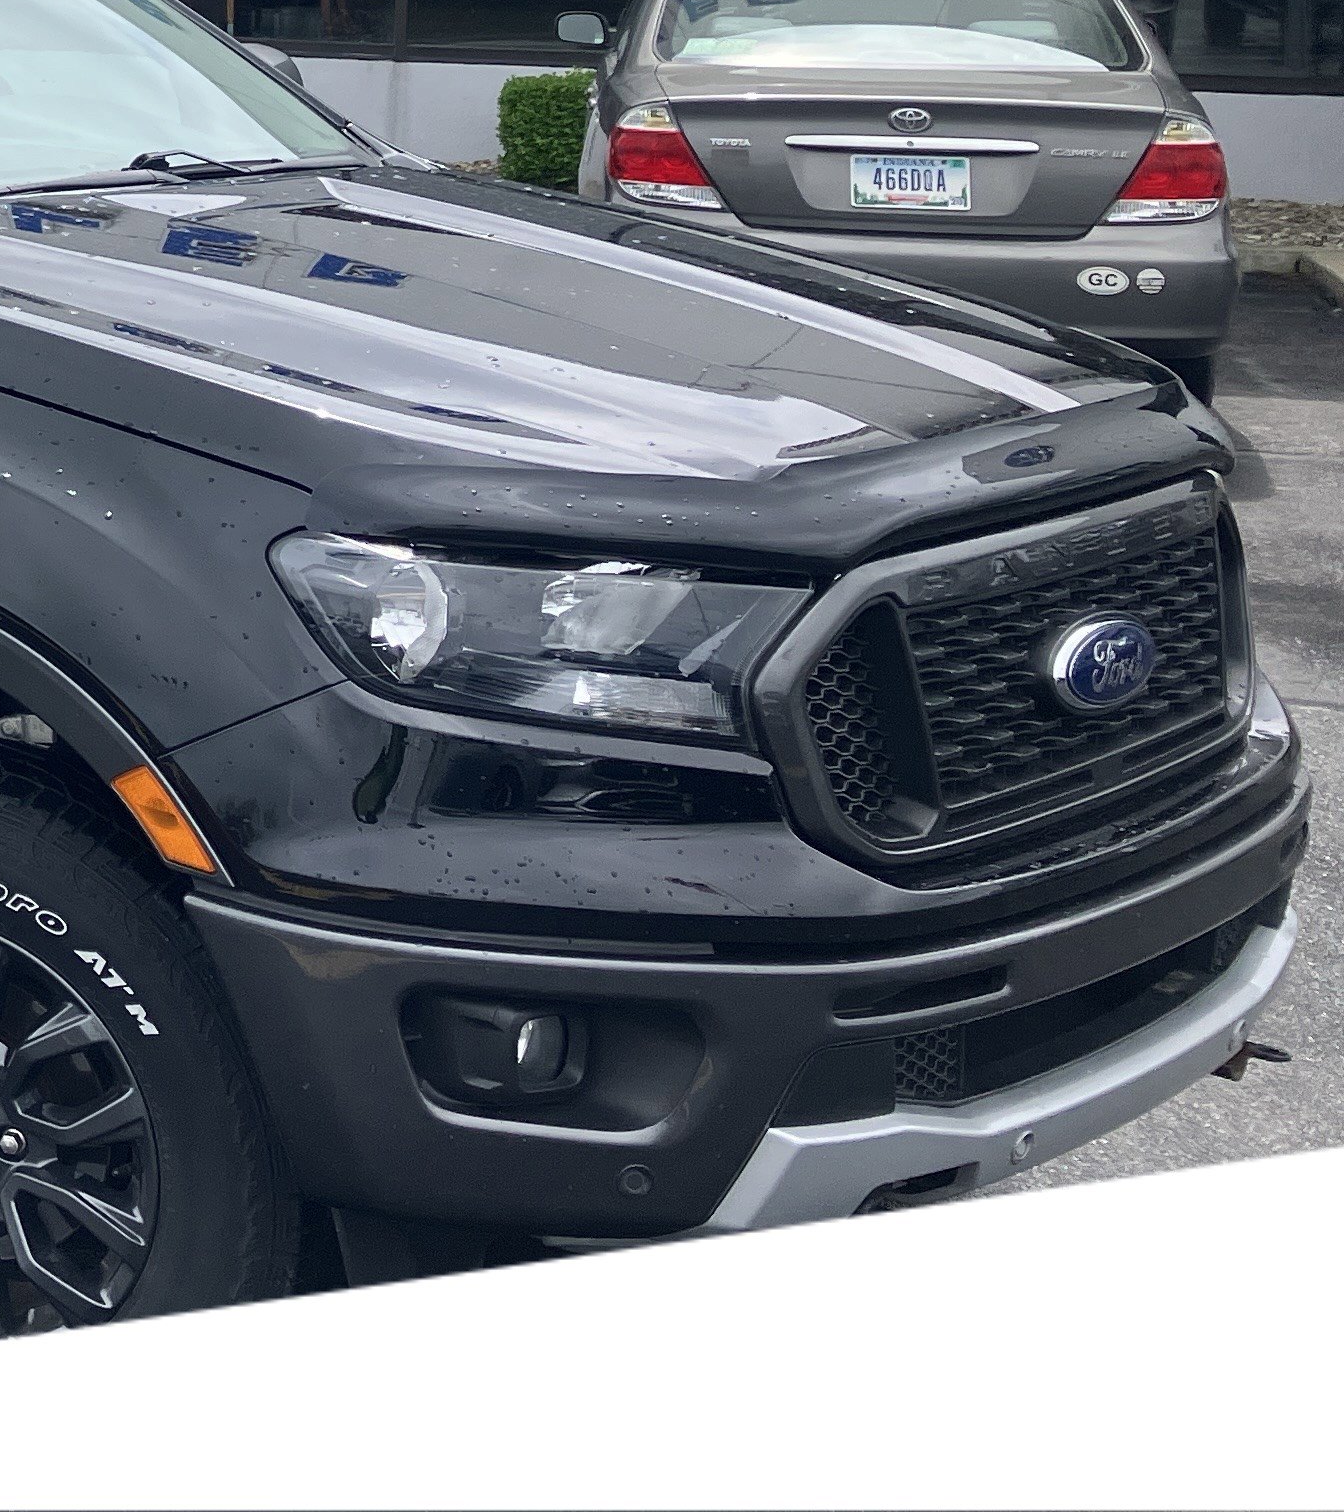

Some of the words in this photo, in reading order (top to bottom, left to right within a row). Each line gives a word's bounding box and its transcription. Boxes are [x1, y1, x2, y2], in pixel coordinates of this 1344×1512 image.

[709, 137, 752, 148] TOYOTA
[1088, 272, 1119, 287] GC
[1091, 636, 1144, 694] Ford
